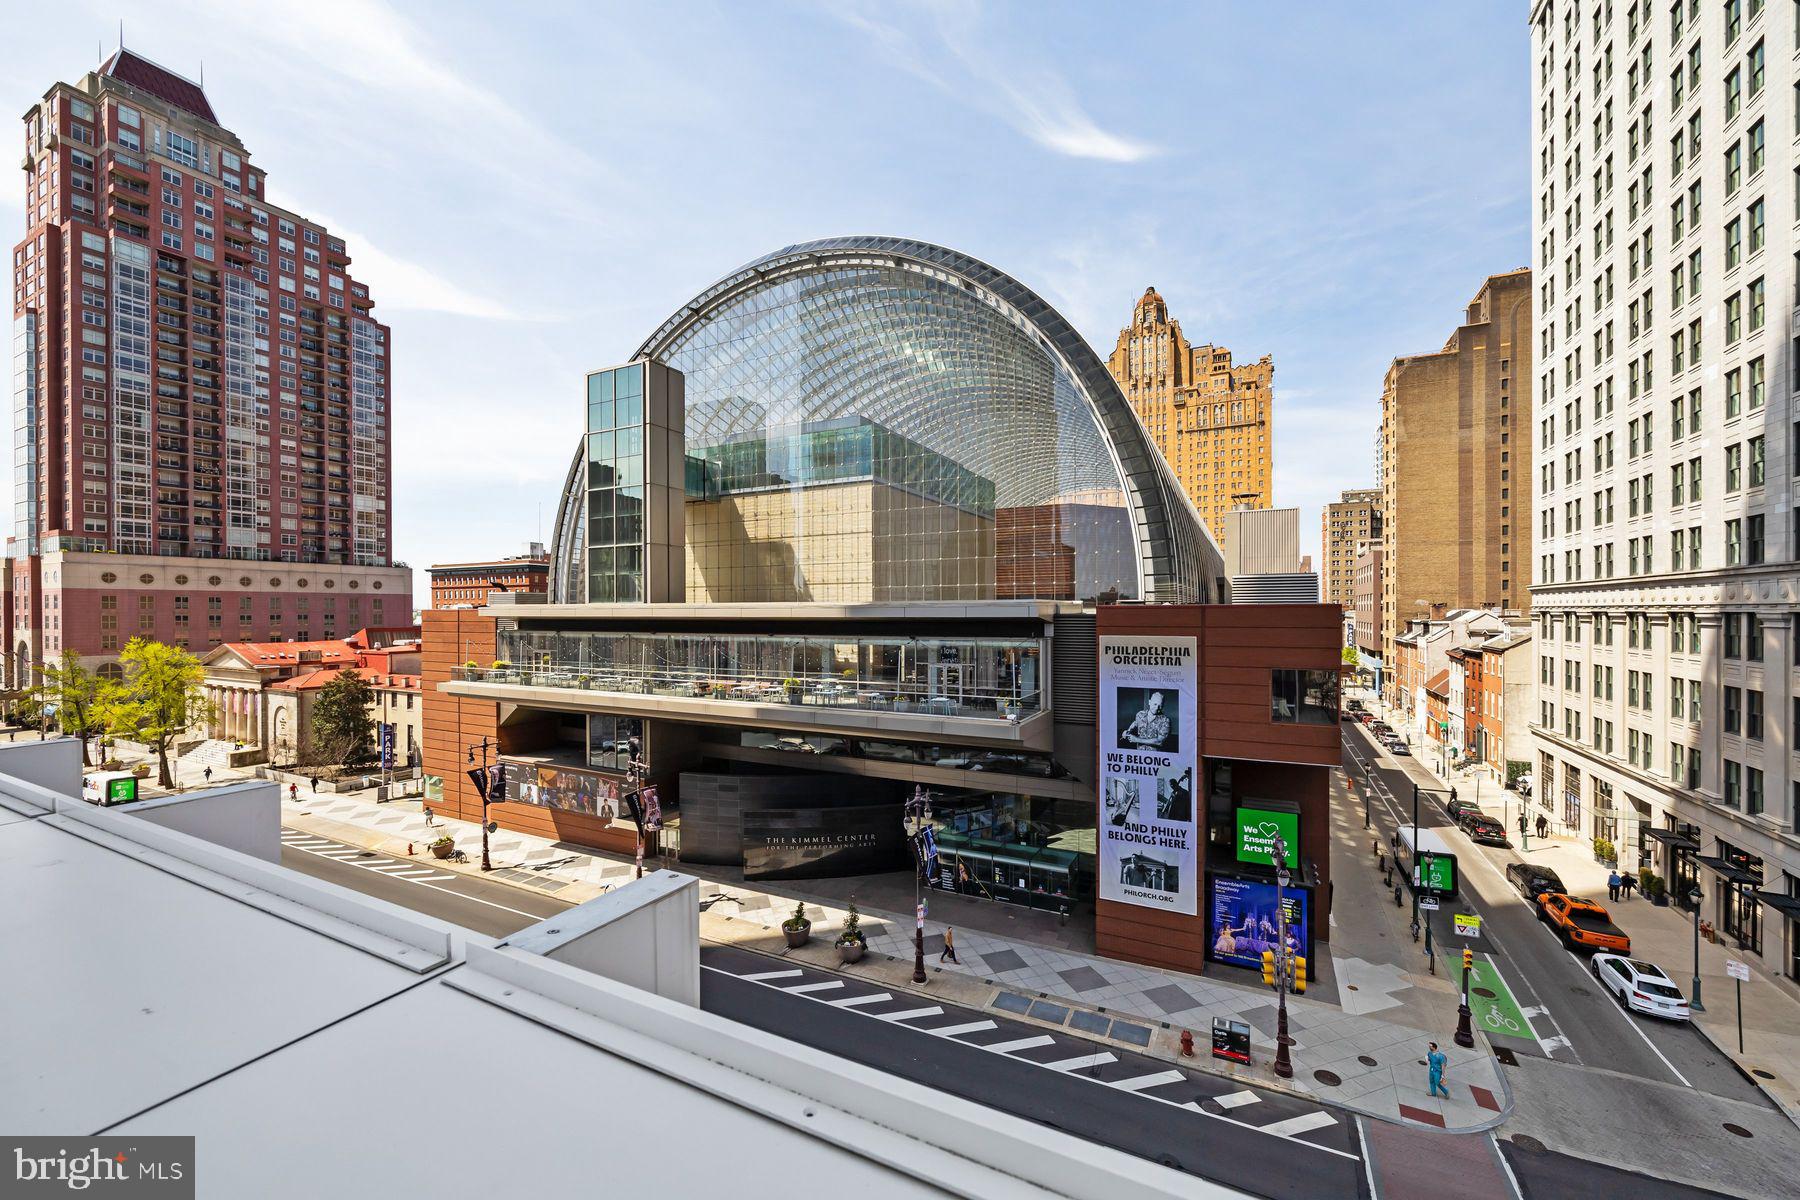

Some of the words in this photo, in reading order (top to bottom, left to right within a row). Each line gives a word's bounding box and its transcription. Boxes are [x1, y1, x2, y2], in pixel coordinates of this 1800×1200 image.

[1105, 646, 1191, 657] PHILADELPHIA
[1113, 655, 1182, 667] ORCHESTRA
[1107, 753, 1124, 763] WE
[1126, 754, 1171, 767] BELONG
[1107, 763, 1122, 773] TO
[1124, 765, 1159, 777] PHILLY
[1124, 822, 1148, 834] AND
[1151, 826, 1187, 839] PHILLY
[1243, 825, 1258, 834] We
[792, 836, 831, 844] KIMMEL
[837, 833, 876, 842] CENTER
[1108, 831, 1157, 845] BELONGS
[1160, 836, 1190, 850] HERE.
[1243, 844, 1262, 853] Arts
[1124, 889, 1174, 903] PHILORCH.ORG
